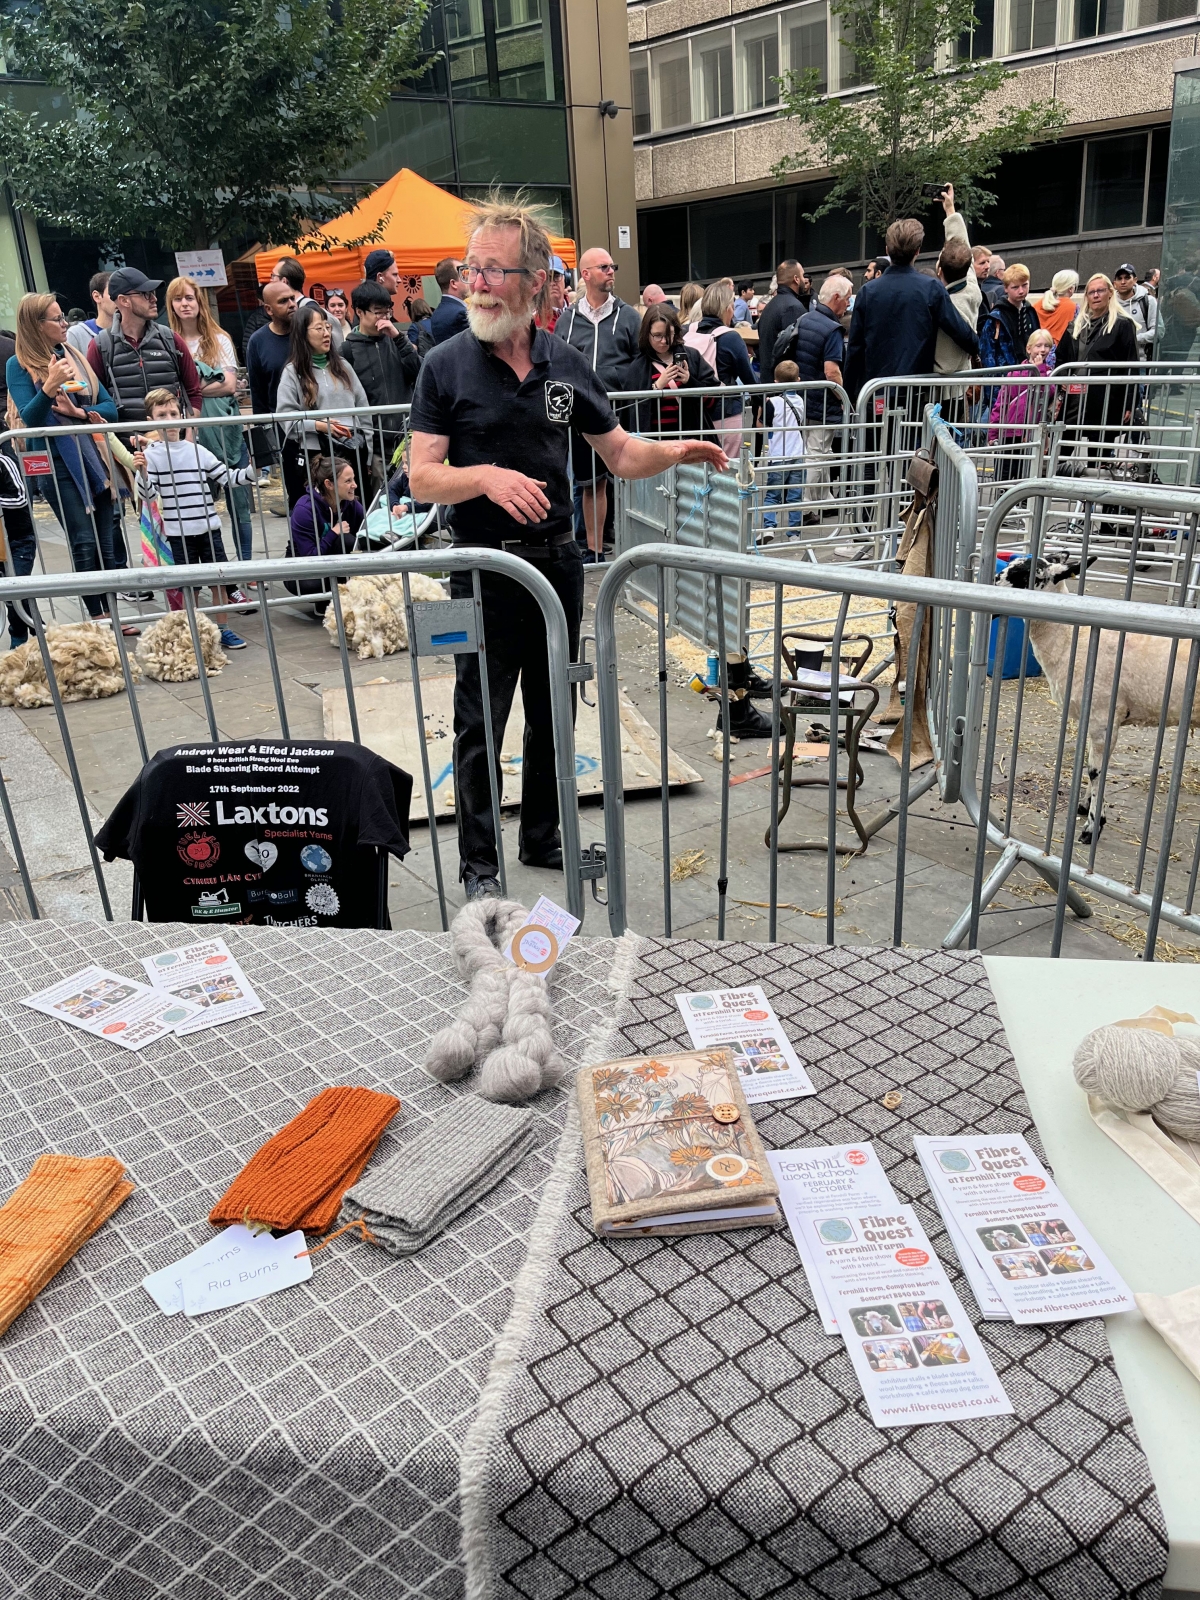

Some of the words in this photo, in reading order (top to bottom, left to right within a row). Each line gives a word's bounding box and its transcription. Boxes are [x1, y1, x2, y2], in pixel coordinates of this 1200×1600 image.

[218, 746, 246, 755] Wear
[248, 745, 257, 754] &
[259, 746, 287, 755] Elfed
[290, 747, 334, 756] Jackson
[249, 756, 269, 764] Strong
[186, 765, 211, 773] Blade
[213, 765, 251, 773] Shearing
[252, 764, 283, 772] Record
[285, 765, 320, 774] Attempt
[216, 801, 328, 826] Laxtons
[264, 830, 307, 838] Specialist
[309, 831, 333, 840] Yarns
[278, 890, 294, 899] Ball
[183, 943, 217, 955] Fibre
[186, 947, 220, 960] Quest
[719, 991, 755, 1002] Fibre
[722, 997, 759, 1008] Quest
[975, 1146, 1021, 1160] Fibre
[981, 1156, 1029, 1173] Quest
[803, 1179, 846, 1187] FEBRUARY
[959, 1173, 993, 1182] Fernhill
[810, 1184, 853, 1193] OCTOBER
[964, 1210, 989, 1218] Fernhill
[858, 1215, 908, 1229] Fibre
[863, 1225, 914, 1244] Quest
[826, 1248, 837, 1256] at
[839, 1245, 877, 1254] Fernhill
[877, 1242, 905, 1250] Farm
[208, 1278, 231, 1292] Ria
[239, 1262, 278, 1283] Burns
[1078, 1275, 1102, 1283] shearing
[839, 1288, 865, 1296] Fernhill
[1018, 1294, 1127, 1315] www.fibrequest.co.uk
[950, 1370, 976, 1378] shearing
[881, 1395, 1000, 1415] www.fibrequest.co.uk
